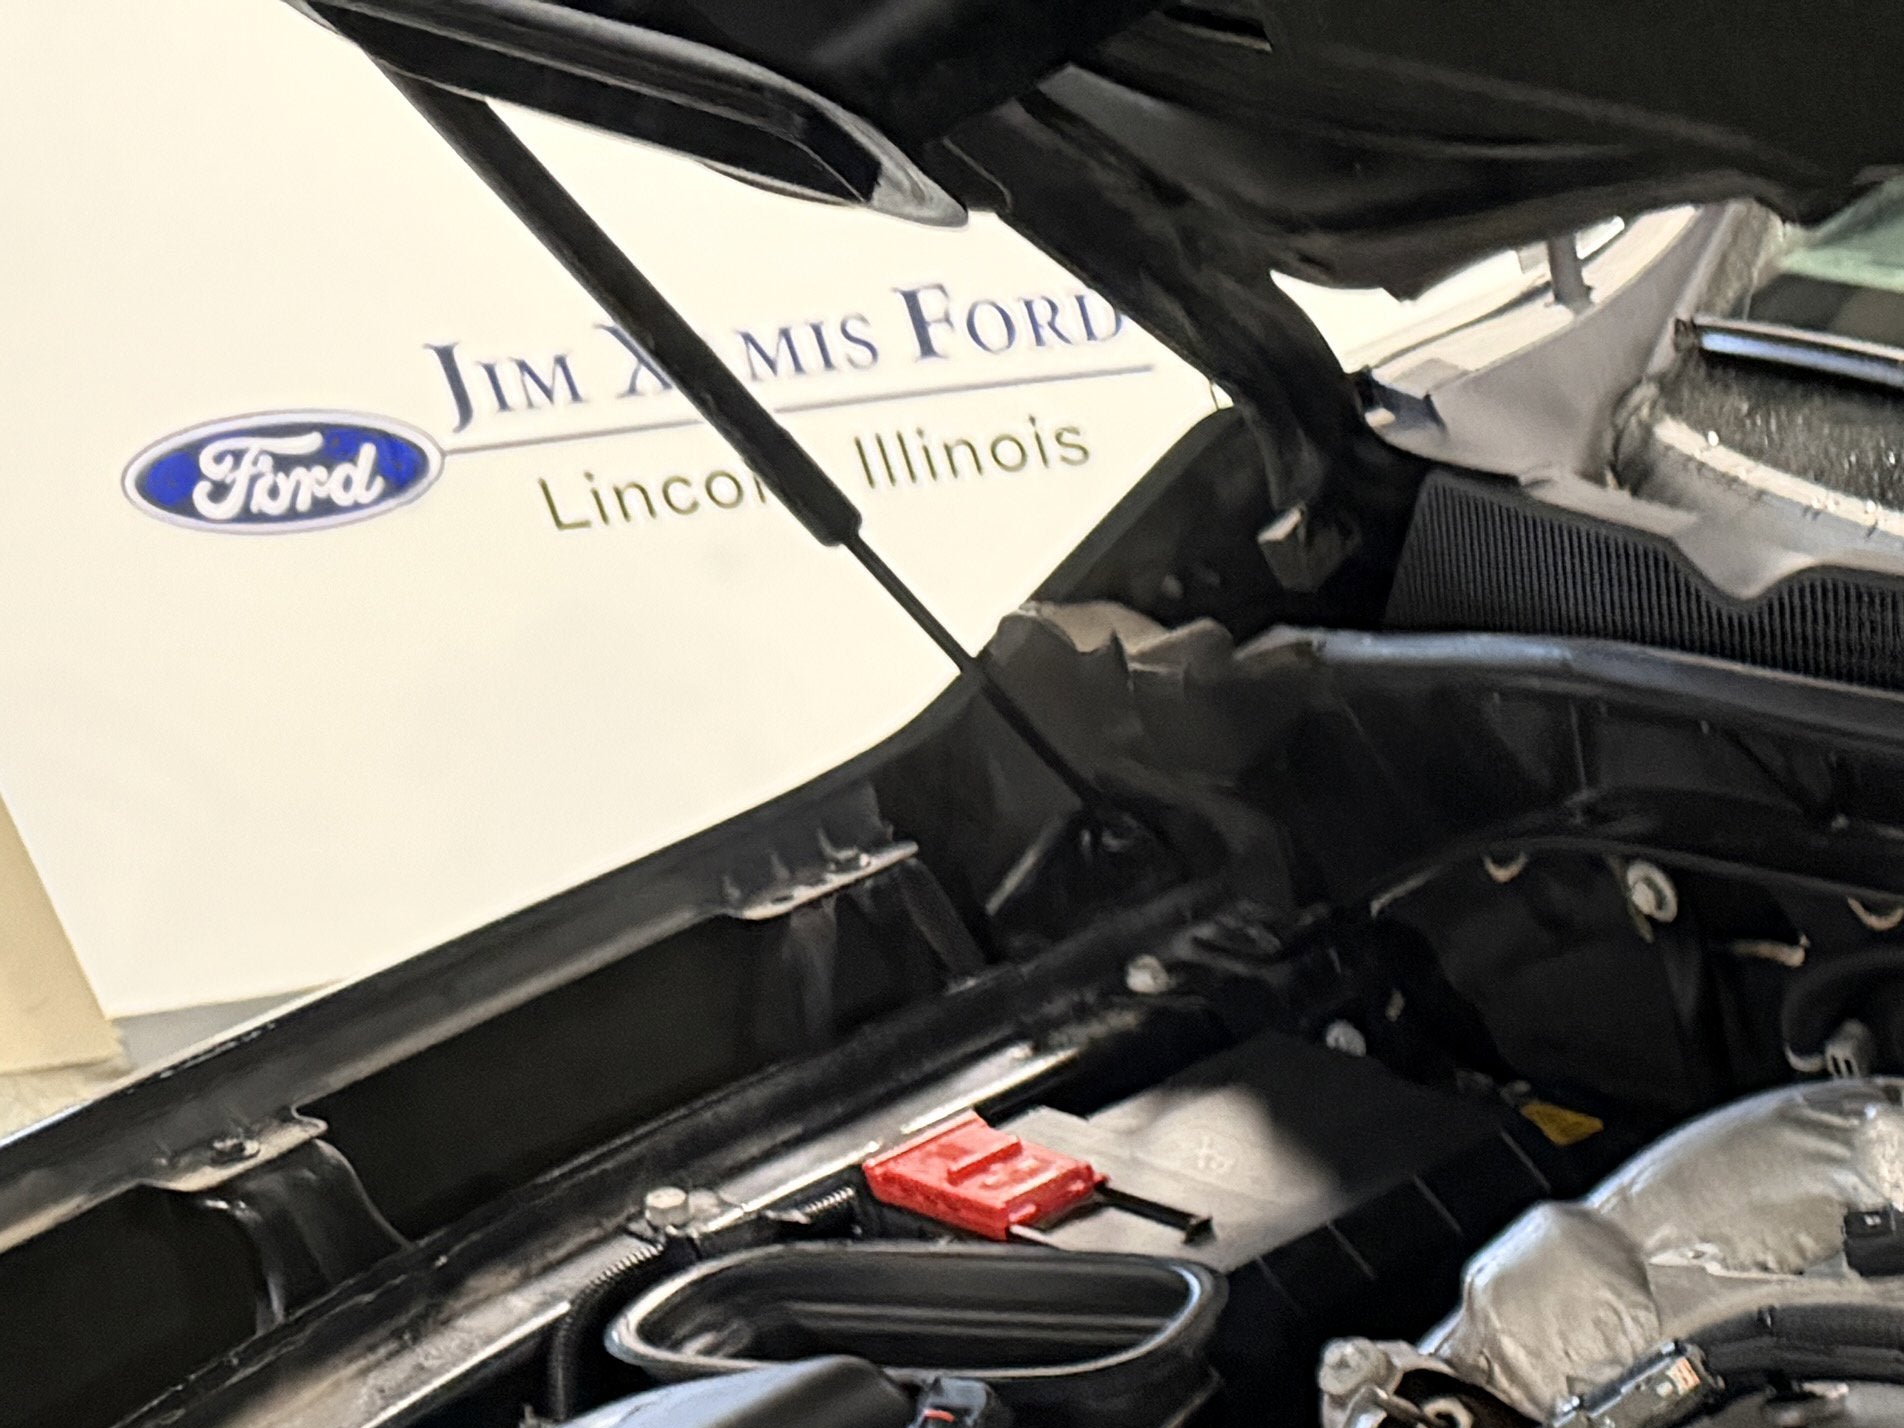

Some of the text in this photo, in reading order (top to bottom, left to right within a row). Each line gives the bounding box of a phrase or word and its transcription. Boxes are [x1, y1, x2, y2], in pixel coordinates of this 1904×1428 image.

[425, 284, 1125, 433] JIM XMIS FORD
[193, 430, 383, 519] Ford
[853, 415, 1091, 489] Illinois
